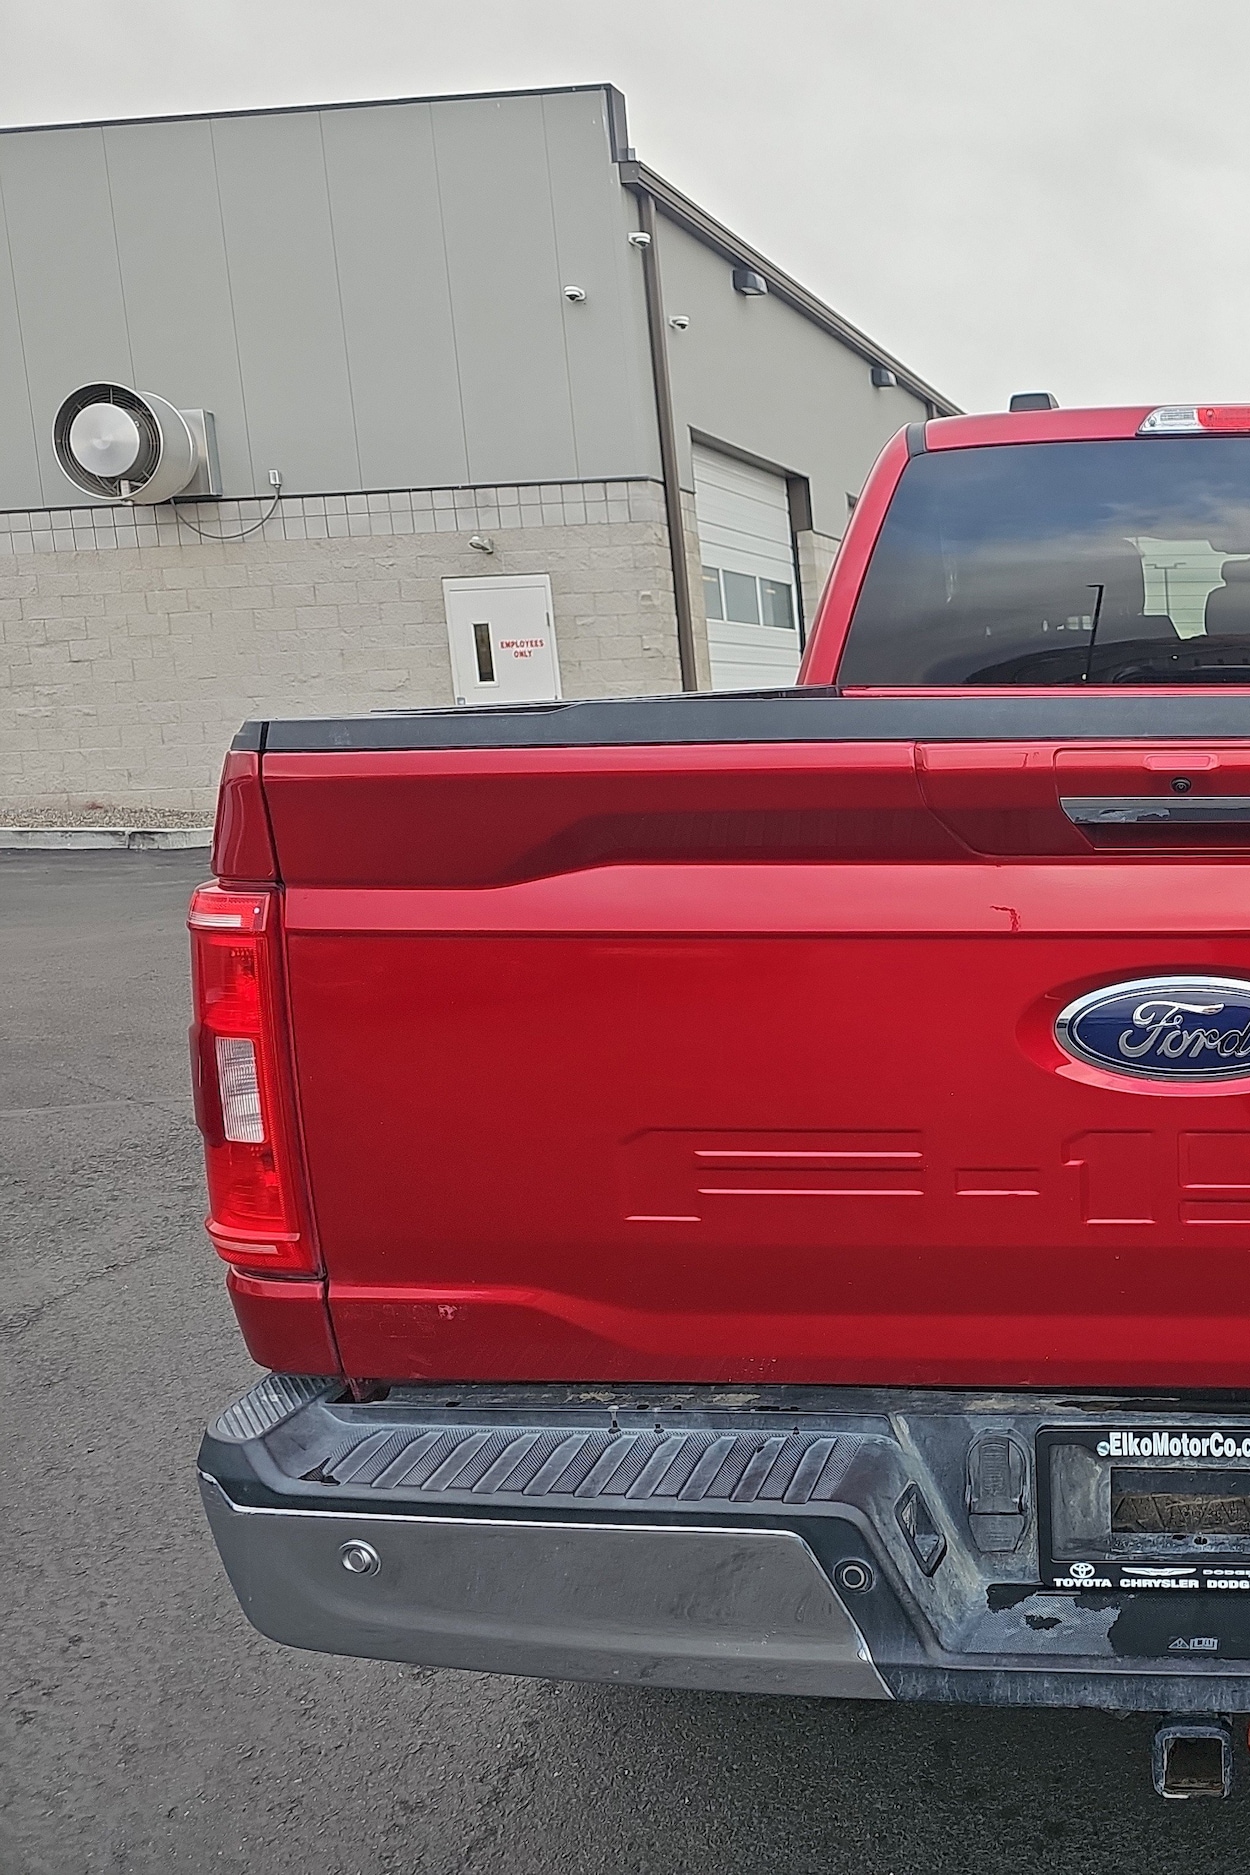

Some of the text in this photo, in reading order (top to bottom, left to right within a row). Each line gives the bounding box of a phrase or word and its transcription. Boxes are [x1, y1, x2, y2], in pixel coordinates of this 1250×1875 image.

[500, 639, 544, 649] EMPLOYEES
[513, 650, 533, 658] ONLY
[1053, 1578, 1112, 1588] TOYOTA
[1119, 1578, 1200, 1589] CHRYSLER
